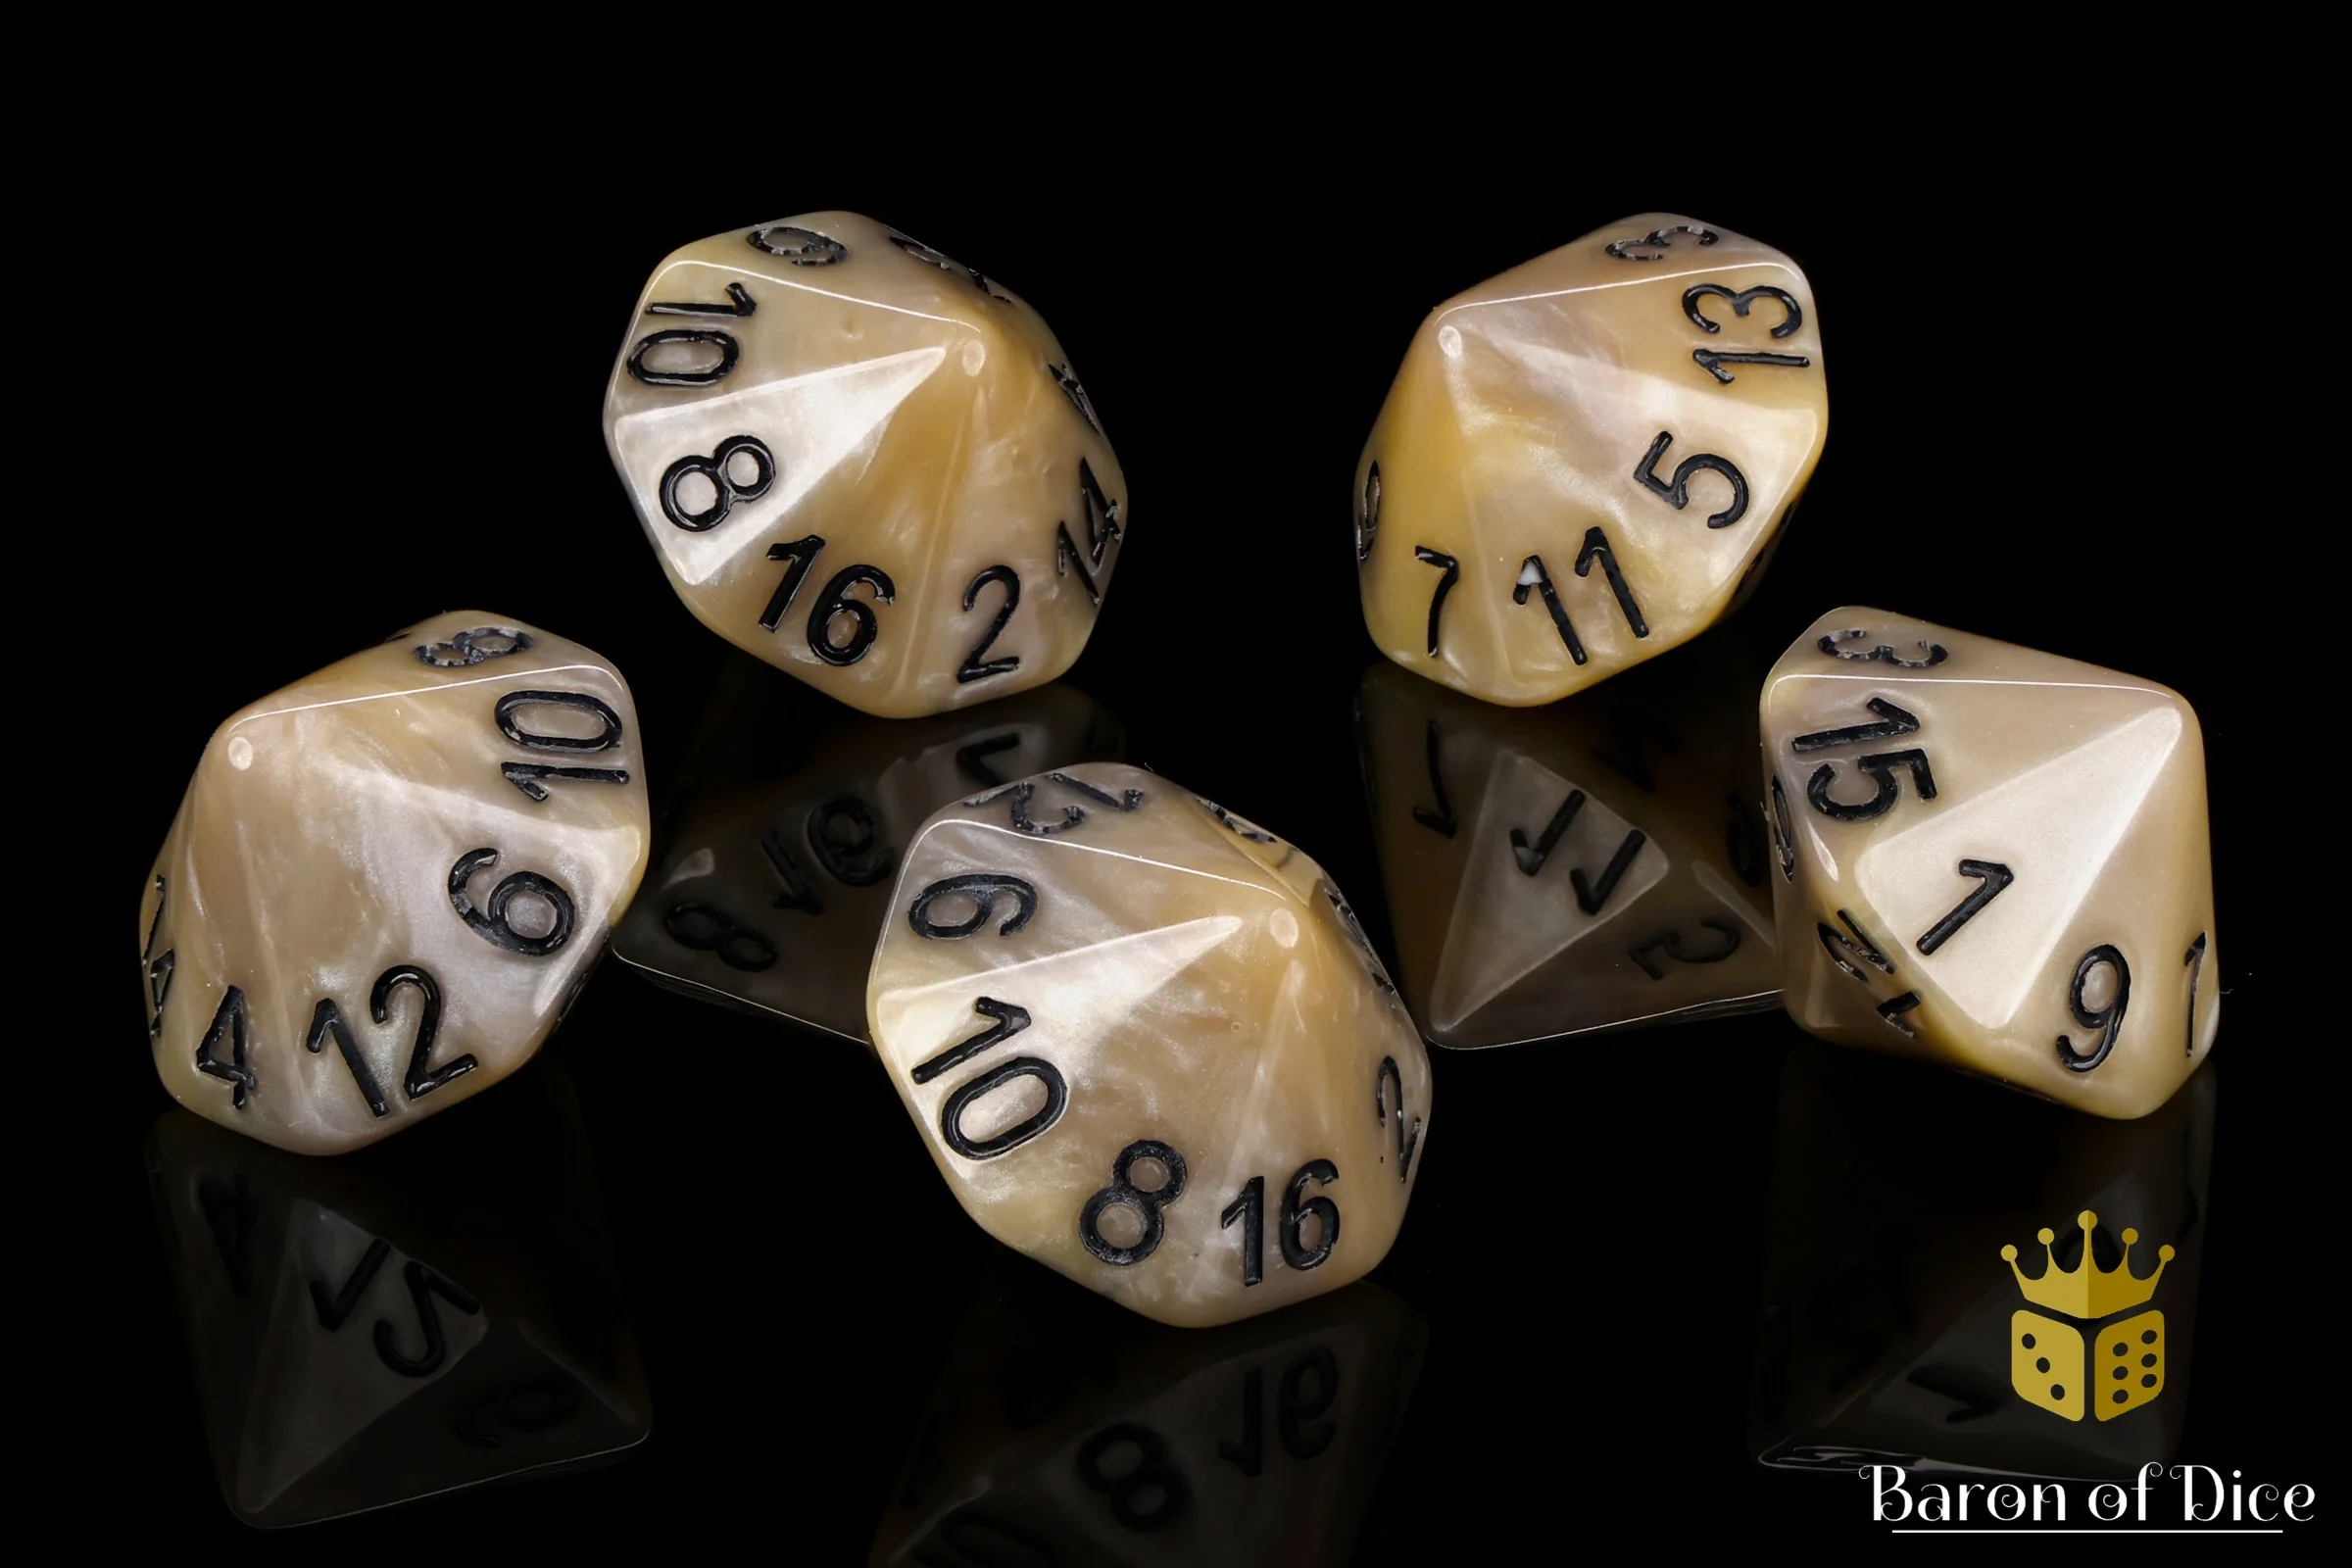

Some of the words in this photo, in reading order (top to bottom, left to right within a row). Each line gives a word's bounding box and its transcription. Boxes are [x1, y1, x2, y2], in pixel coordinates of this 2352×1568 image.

[627, 282, 757, 386] 10
[1682, 283, 1810, 384] 13
[660, 434, 776, 532] 8
[1634, 431, 1749, 529] 5
[413, 627, 535, 667] 8
[759, 534, 896, 667] 16
[956, 564, 1020, 683] 2
[1415, 545, 1459, 658] 7
[1513, 526, 1649, 665] 11
[1817, 628, 1948, 668] 3
[494, 689, 630, 802] 10
[1790, 696, 1937, 822] 15
[448, 848, 575, 956] 6
[1916, 858, 2015, 956] 1
[197, 985, 257, 1110] 4
[306, 964, 478, 1117] 12
[2057, 944, 2132, 1073] 9
[911, 996, 1070, 1161] 10
[1376, 1055, 1423, 1184] 2
[1079, 1139, 1188, 1266] 8
[1220, 1158, 1341, 1287] 16
